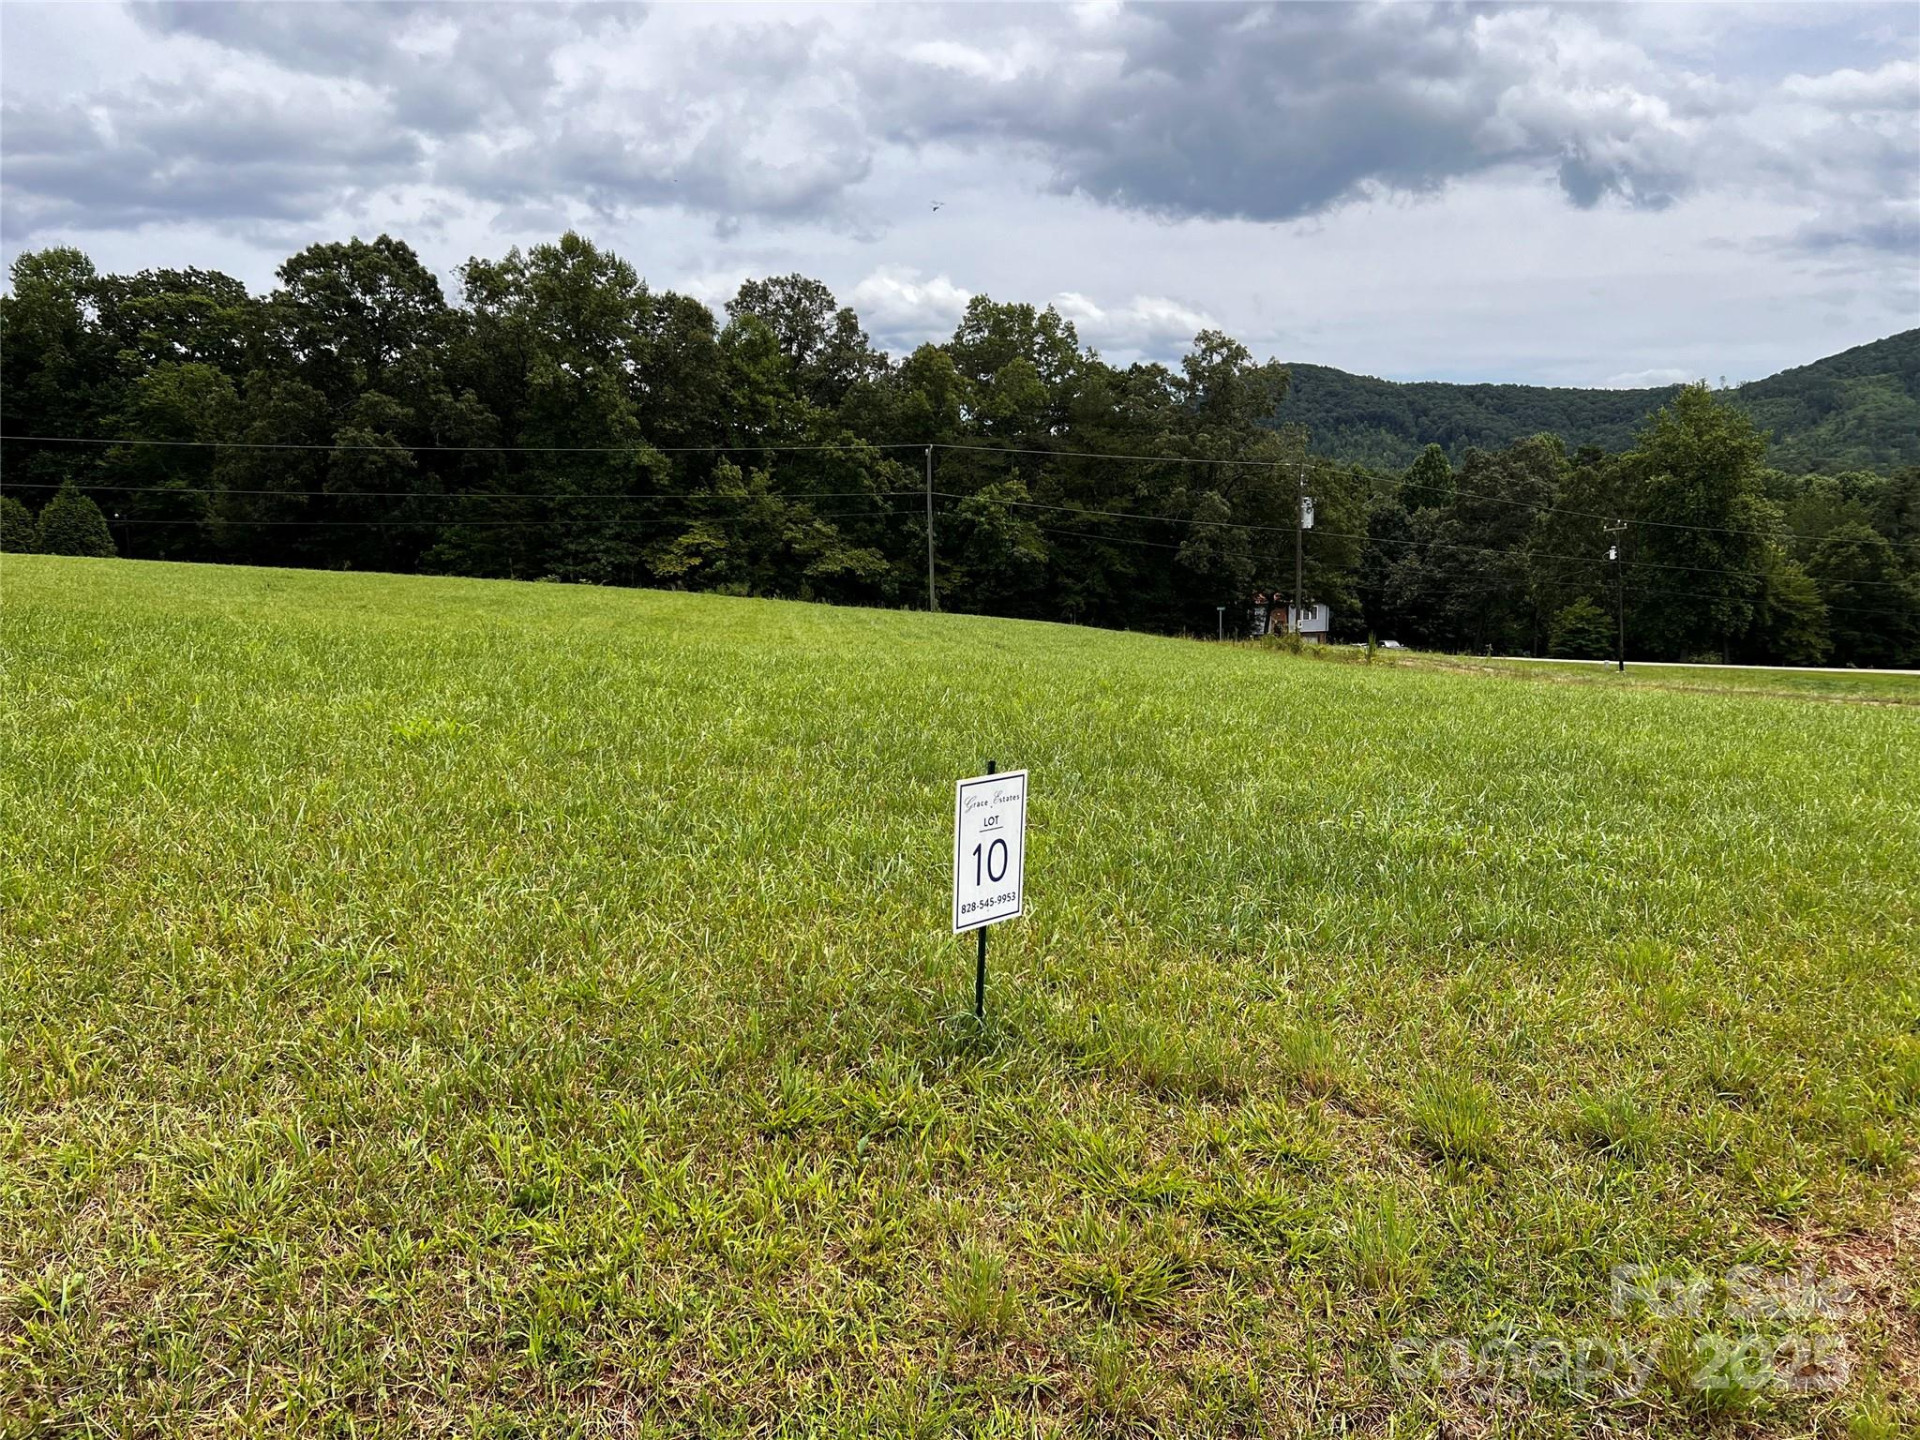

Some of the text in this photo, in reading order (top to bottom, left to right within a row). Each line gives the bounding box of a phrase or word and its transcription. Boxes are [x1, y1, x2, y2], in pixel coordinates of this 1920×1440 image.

[964, 790, 1020, 813] Grace Estates
[983, 815, 1000, 827] LOT
[972, 838, 1008, 886] 10
[961, 891, 1016, 914] 828-545-9953
